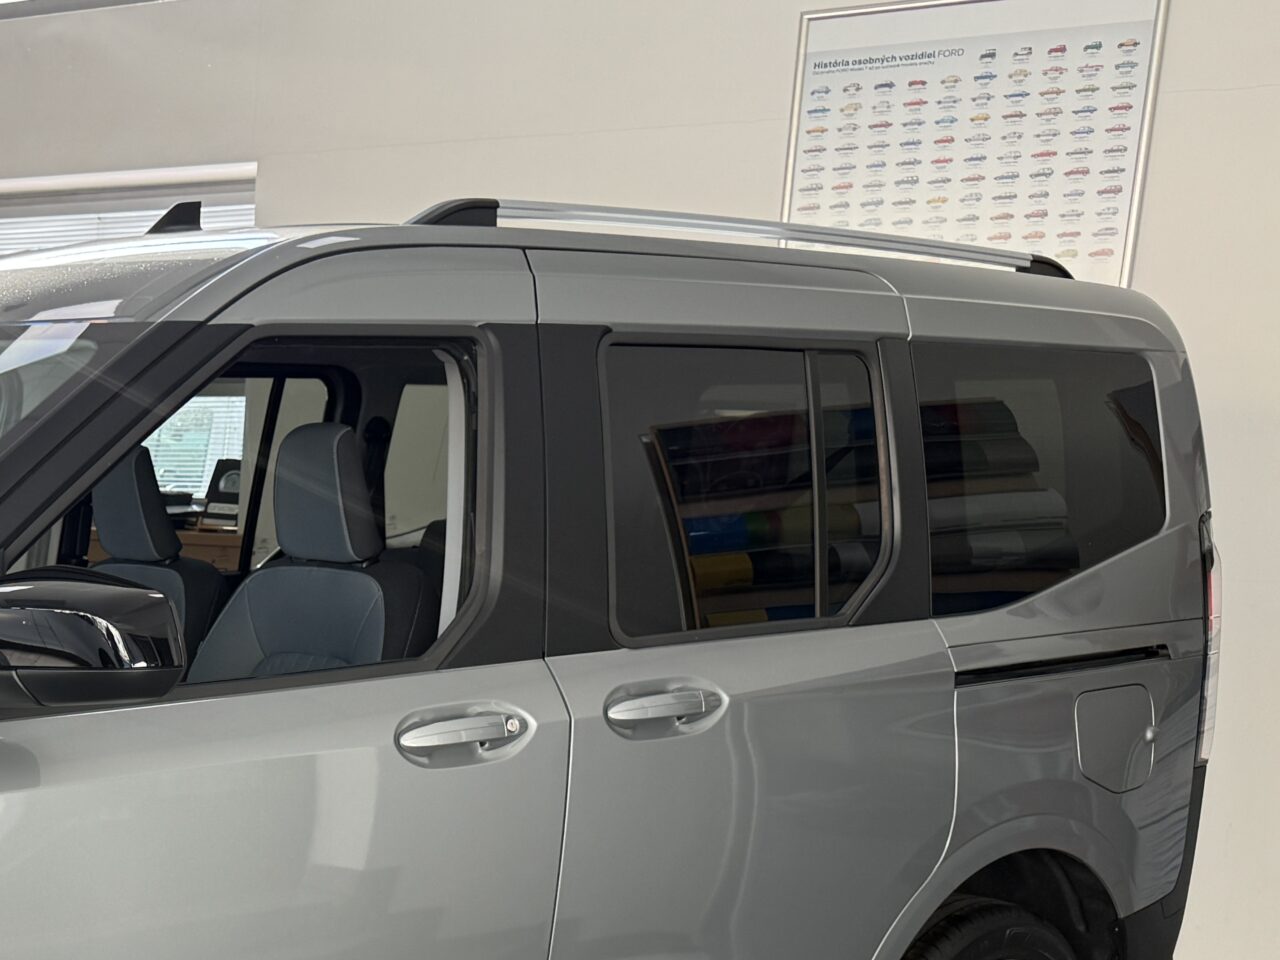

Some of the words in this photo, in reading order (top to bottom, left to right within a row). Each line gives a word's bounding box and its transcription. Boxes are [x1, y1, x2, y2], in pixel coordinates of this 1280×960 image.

[851, 54, 897, 66] osobných
[899, 50, 936, 61] vozidiel
[937, 48, 965, 58] FORD
